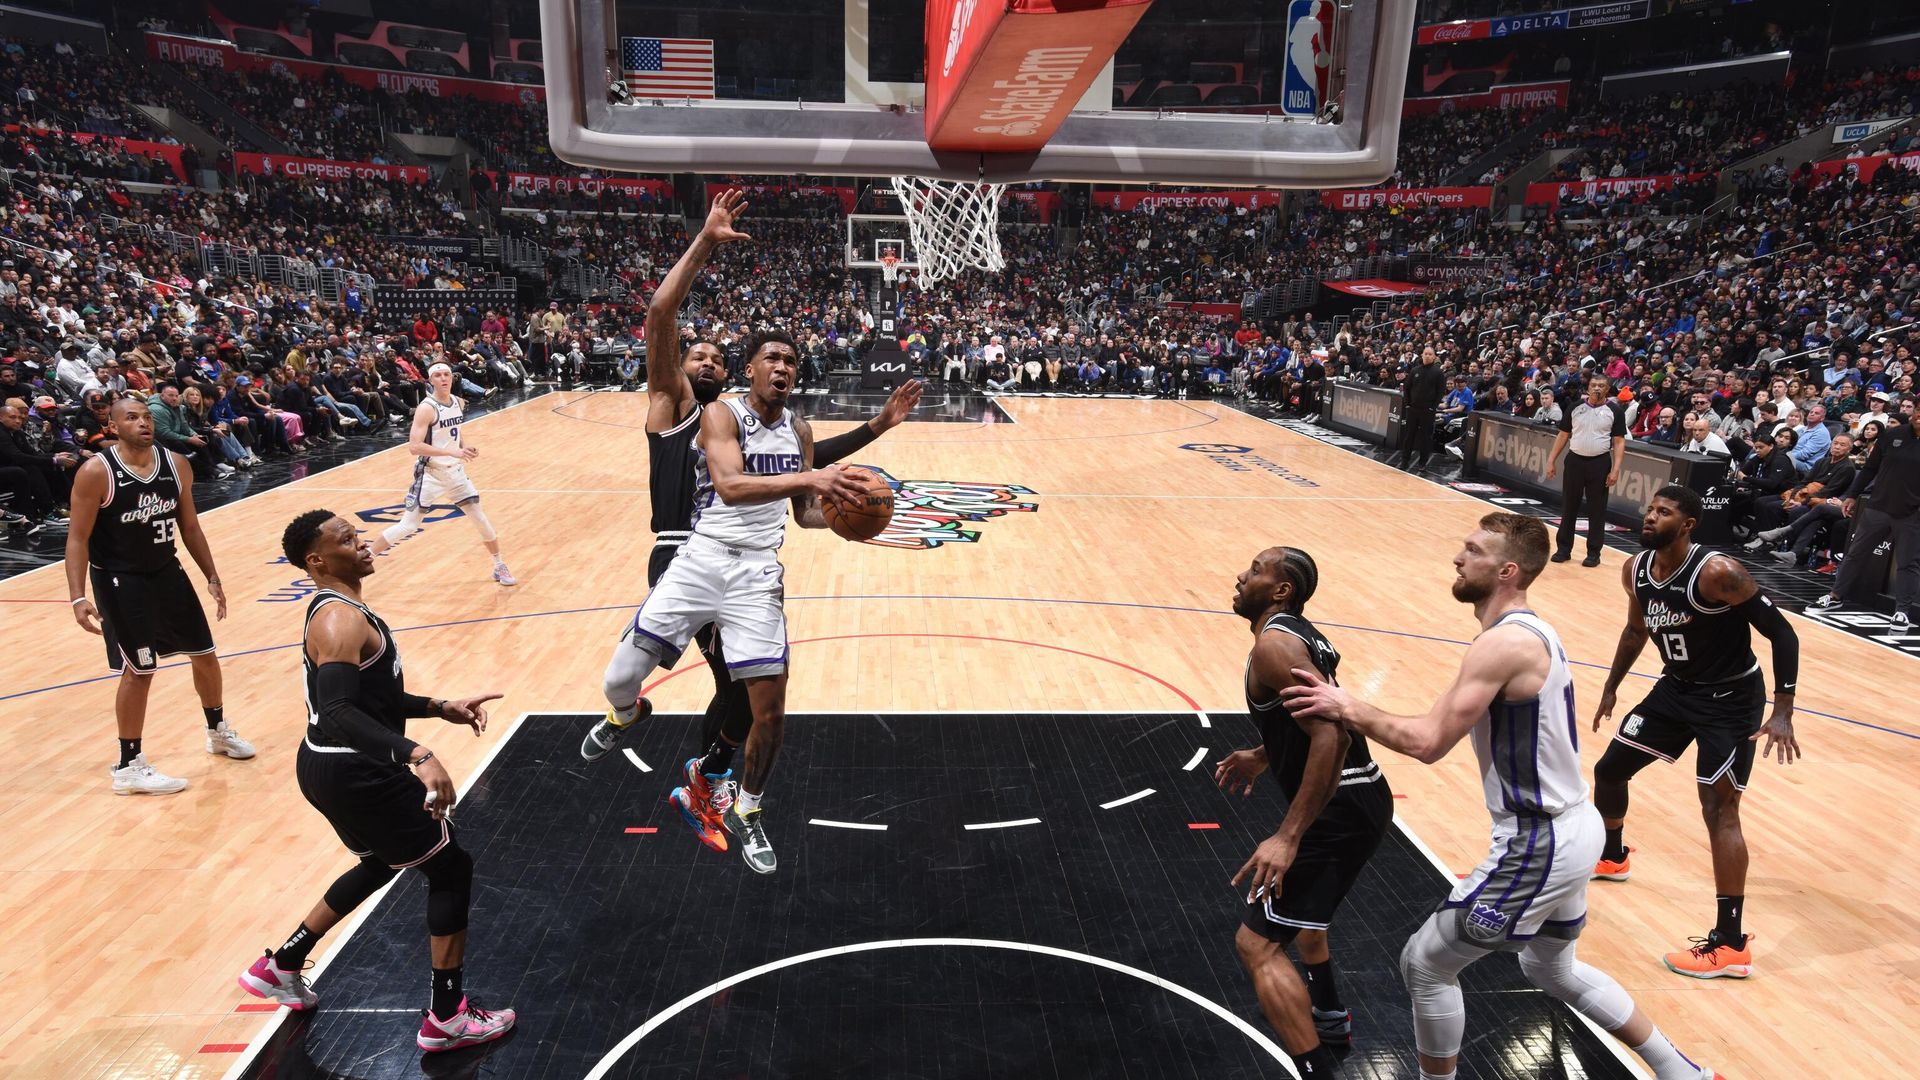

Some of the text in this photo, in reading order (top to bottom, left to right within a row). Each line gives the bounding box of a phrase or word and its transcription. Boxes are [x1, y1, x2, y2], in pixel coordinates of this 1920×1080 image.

[1582, 4, 1631, 17] ILWU Local 13
[1512, 15, 1561, 31] DELTA
[1580, 14, 1631, 26] Longshoreman
[172, 43, 224, 68] CLIPPERS
[1288, 90, 1311, 109] NBA
[1846, 128, 1866, 137] UCLA
[428, 245, 464, 254] EXPRESS
[870, 362, 906, 373] KIA
[1339, 389, 1383, 431] betway
[439, 415, 464, 429] KINGS
[747, 416, 754, 426] 6
[449, 427, 458, 441] 9
[1483, 424, 1548, 484] betway
[741, 453, 801, 474] KINGS
[116, 470, 124, 479] 6
[138, 492, 161, 509] los
[120, 499, 178, 524] angeles
[152, 517, 177, 545] 33
[1638, 569, 1645, 578] 6
[1669, 585, 1686, 594] honey
[1647, 599, 1669, 616] los
[1643, 610, 1691, 633] ngeles
[1661, 633, 1689, 661] 13
